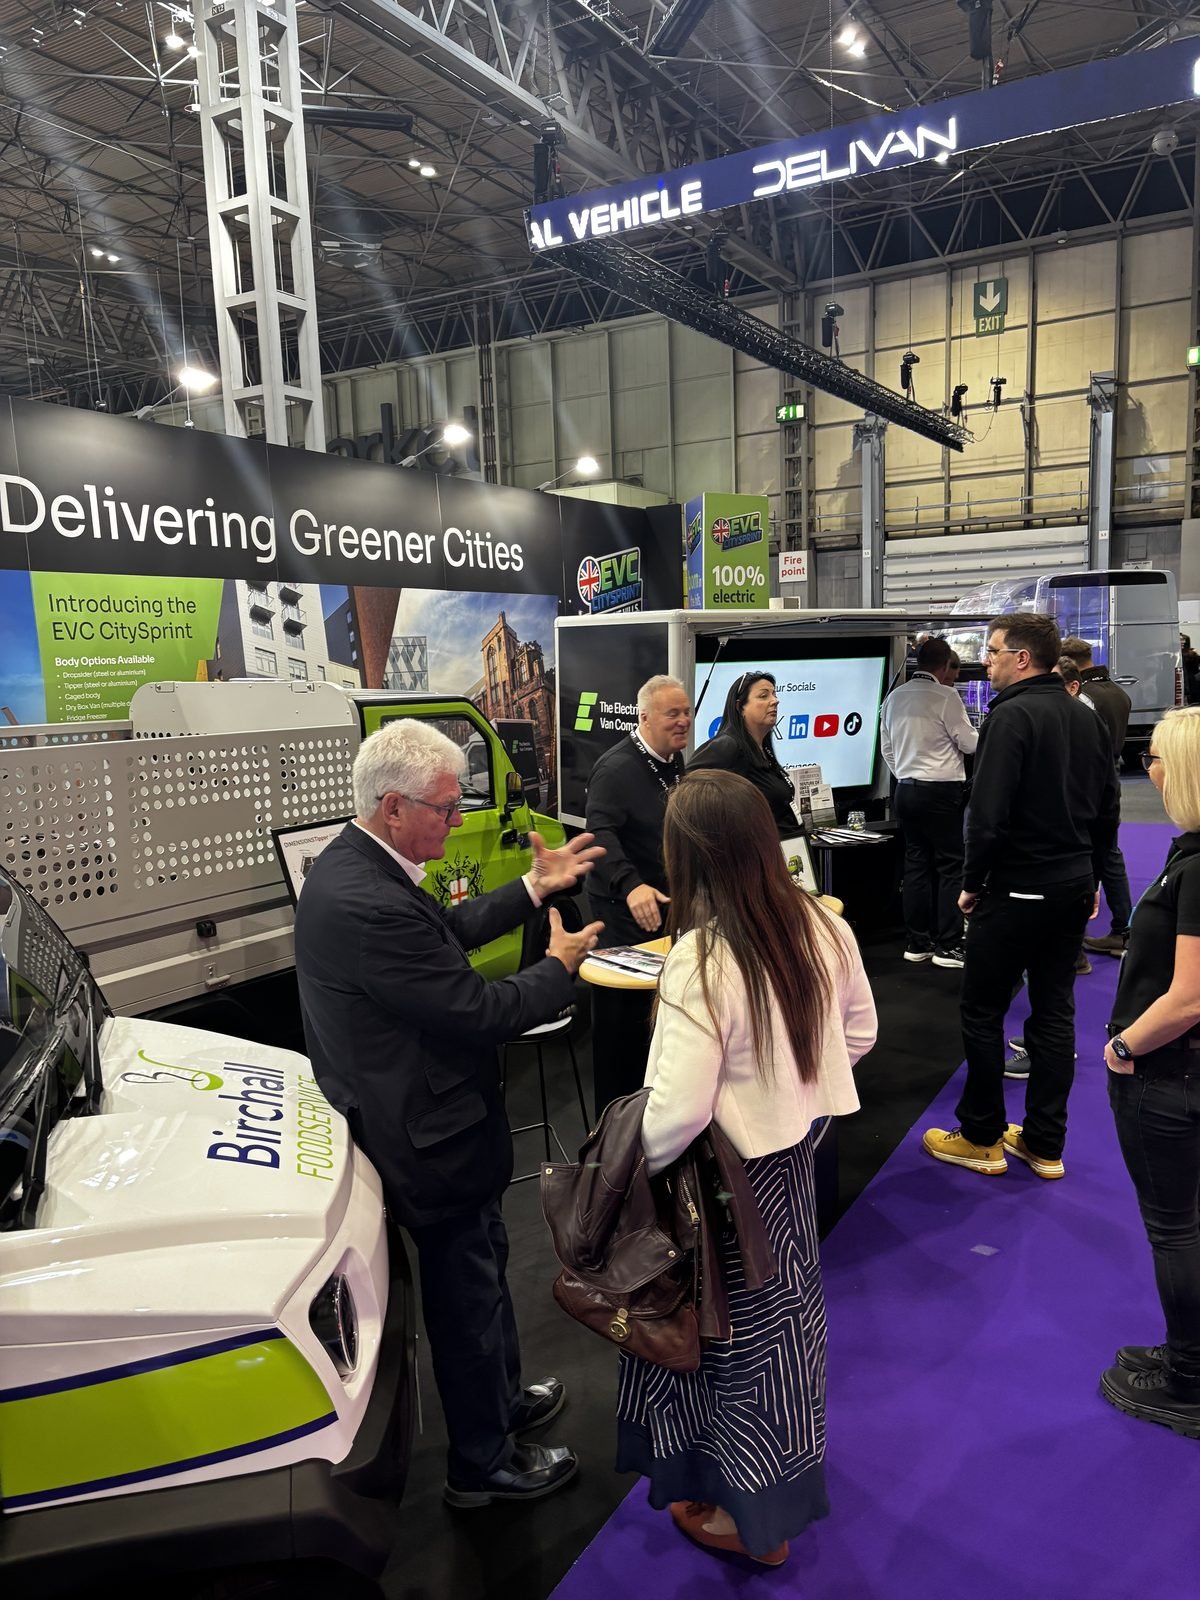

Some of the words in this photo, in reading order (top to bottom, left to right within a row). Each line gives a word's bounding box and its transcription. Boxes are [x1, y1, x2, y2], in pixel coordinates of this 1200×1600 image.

[752, 116, 959, 198] DELIVAN
[568, 180, 704, 240] VEHICLE
[978, 315, 1002, 333] EXIT
[0, 473, 278, 564] Delivering
[289, 508, 436, 564] Greener
[443, 527, 525, 572] Cities
[730, 513, 760, 537] EVC
[600, 551, 639, 591] EVC
[783, 556, 803, 566] Fire
[712, 565, 766, 587] 100%
[781, 566, 806, 578] point
[48, 594, 163, 618] Introducing
[168, 597, 197, 614] the
[591, 582, 641, 611] CITYSPRINT
[713, 589, 756, 604] electric
[52, 621, 95, 641] EVC
[99, 621, 193, 644] CitySprint
[55, 657, 80, 668] Body
[80, 656, 117, 667] Options
[117, 654, 155, 664] Available
[63, 682, 83, 690] Tipper
[83, 681, 100, 689] (steel
[107, 679, 138, 687] aluminium)
[775, 685, 786, 693] ur
[786, 681, 816, 692] Socials
[65, 704, 77, 712] Dry
[600, 701, 613, 714] The
[614, 702, 639, 716] Electri
[600, 717, 614, 730] Van
[206, 1061, 286, 1169] Birchall
